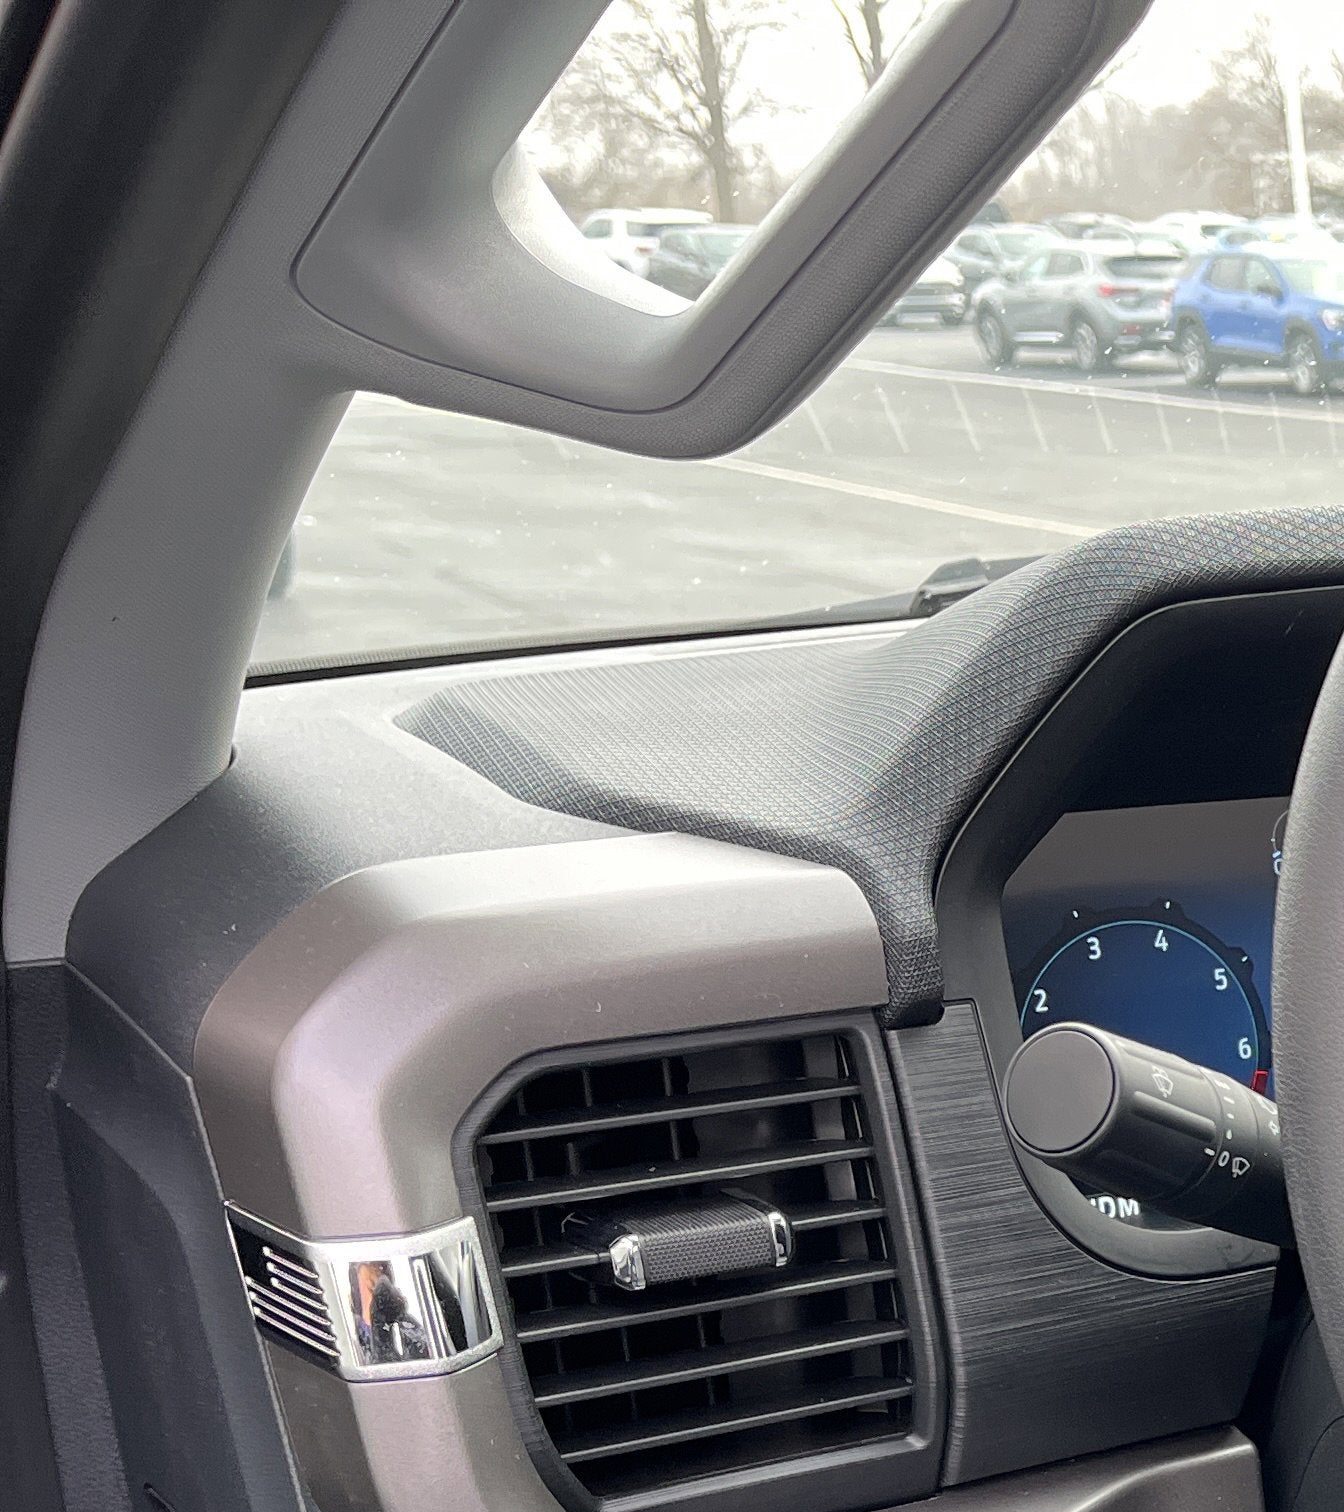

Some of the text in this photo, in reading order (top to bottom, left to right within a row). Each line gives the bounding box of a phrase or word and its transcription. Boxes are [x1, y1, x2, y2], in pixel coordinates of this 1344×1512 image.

[1087, 936, 1101, 960] 3
[1154, 929, 1169, 952] 4
[1214, 968, 1228, 990] 5
[1034, 989, 1048, 1013] 2
[1238, 1037, 1252, 1060] 6
